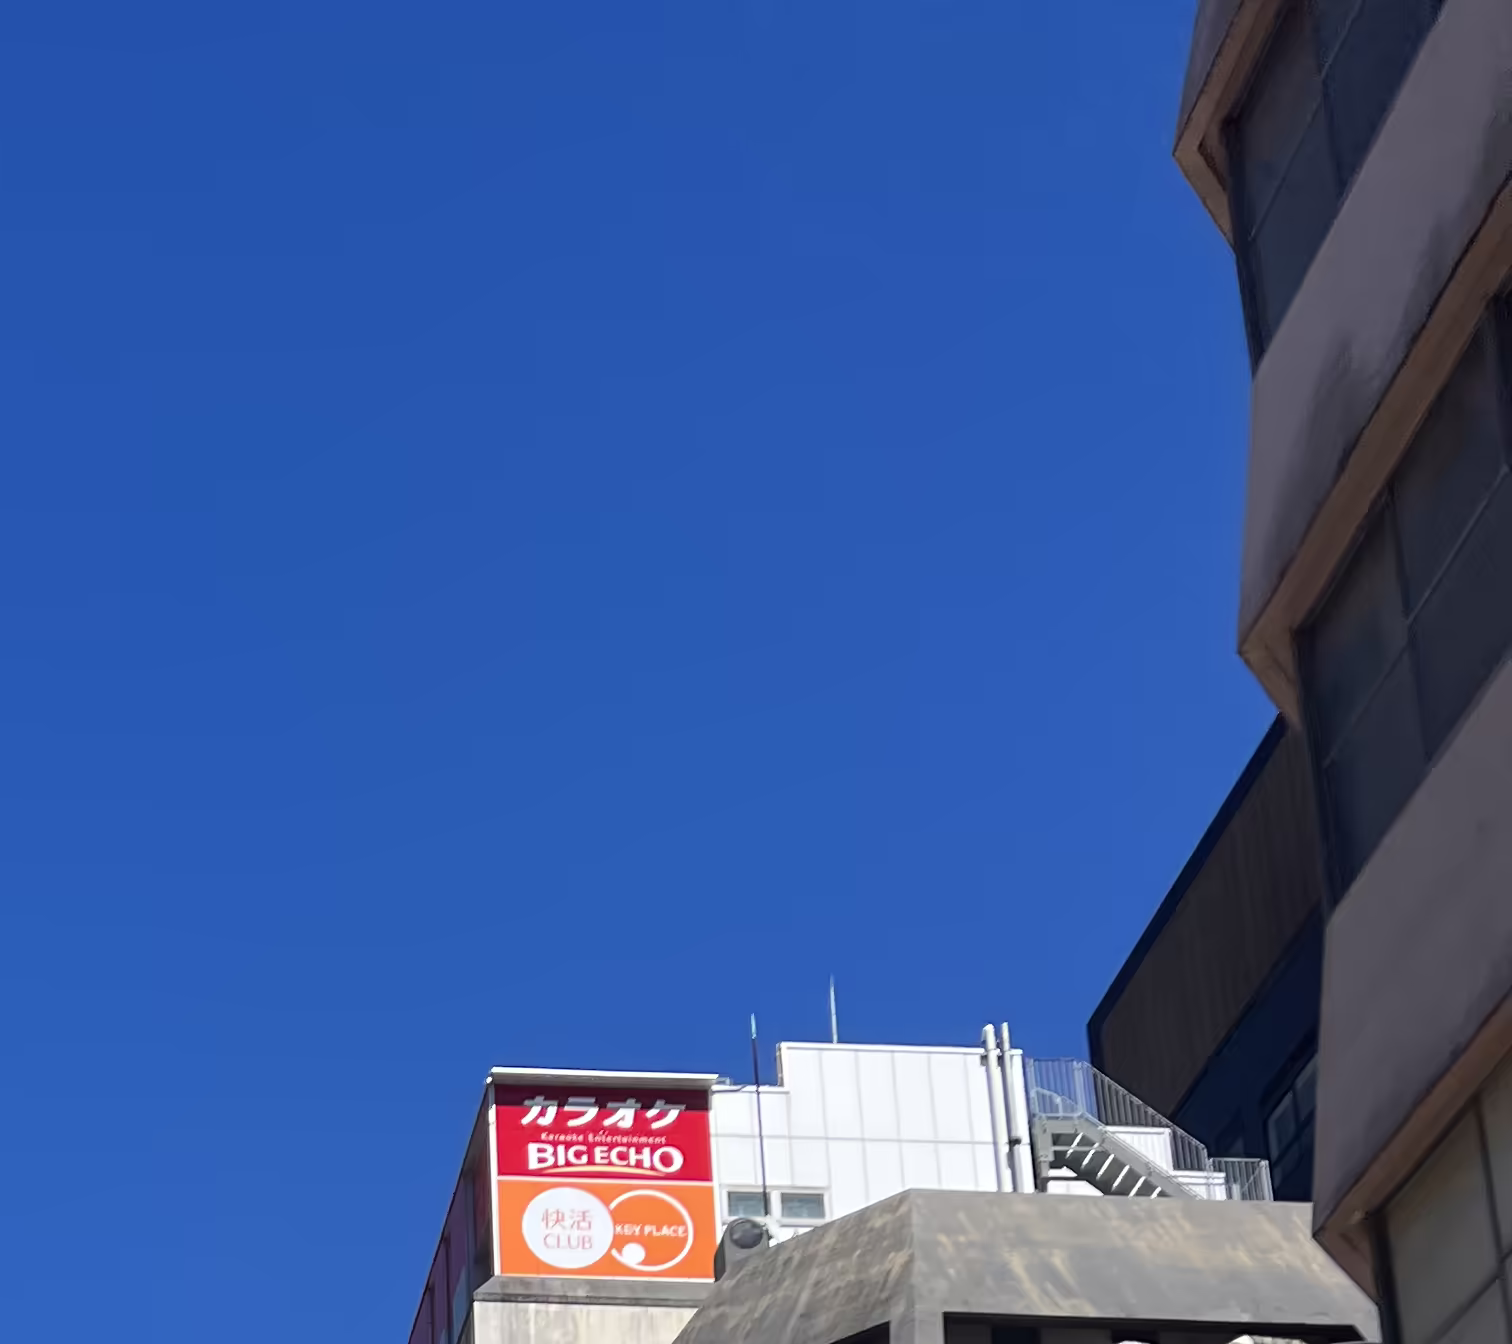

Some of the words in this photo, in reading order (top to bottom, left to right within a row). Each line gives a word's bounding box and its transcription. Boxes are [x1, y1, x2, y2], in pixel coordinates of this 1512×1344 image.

[521, 1095, 687, 1130] カラオケ
[541, 1132, 584, 1143] Karaoke
[588, 1130, 667, 1144] Entertainment
[528, 1142, 589, 1171] BIG
[594, 1145, 684, 1174] ECHO
[541, 1208, 593, 1232] 快活
[543, 1233, 593, 1251] CLUB
